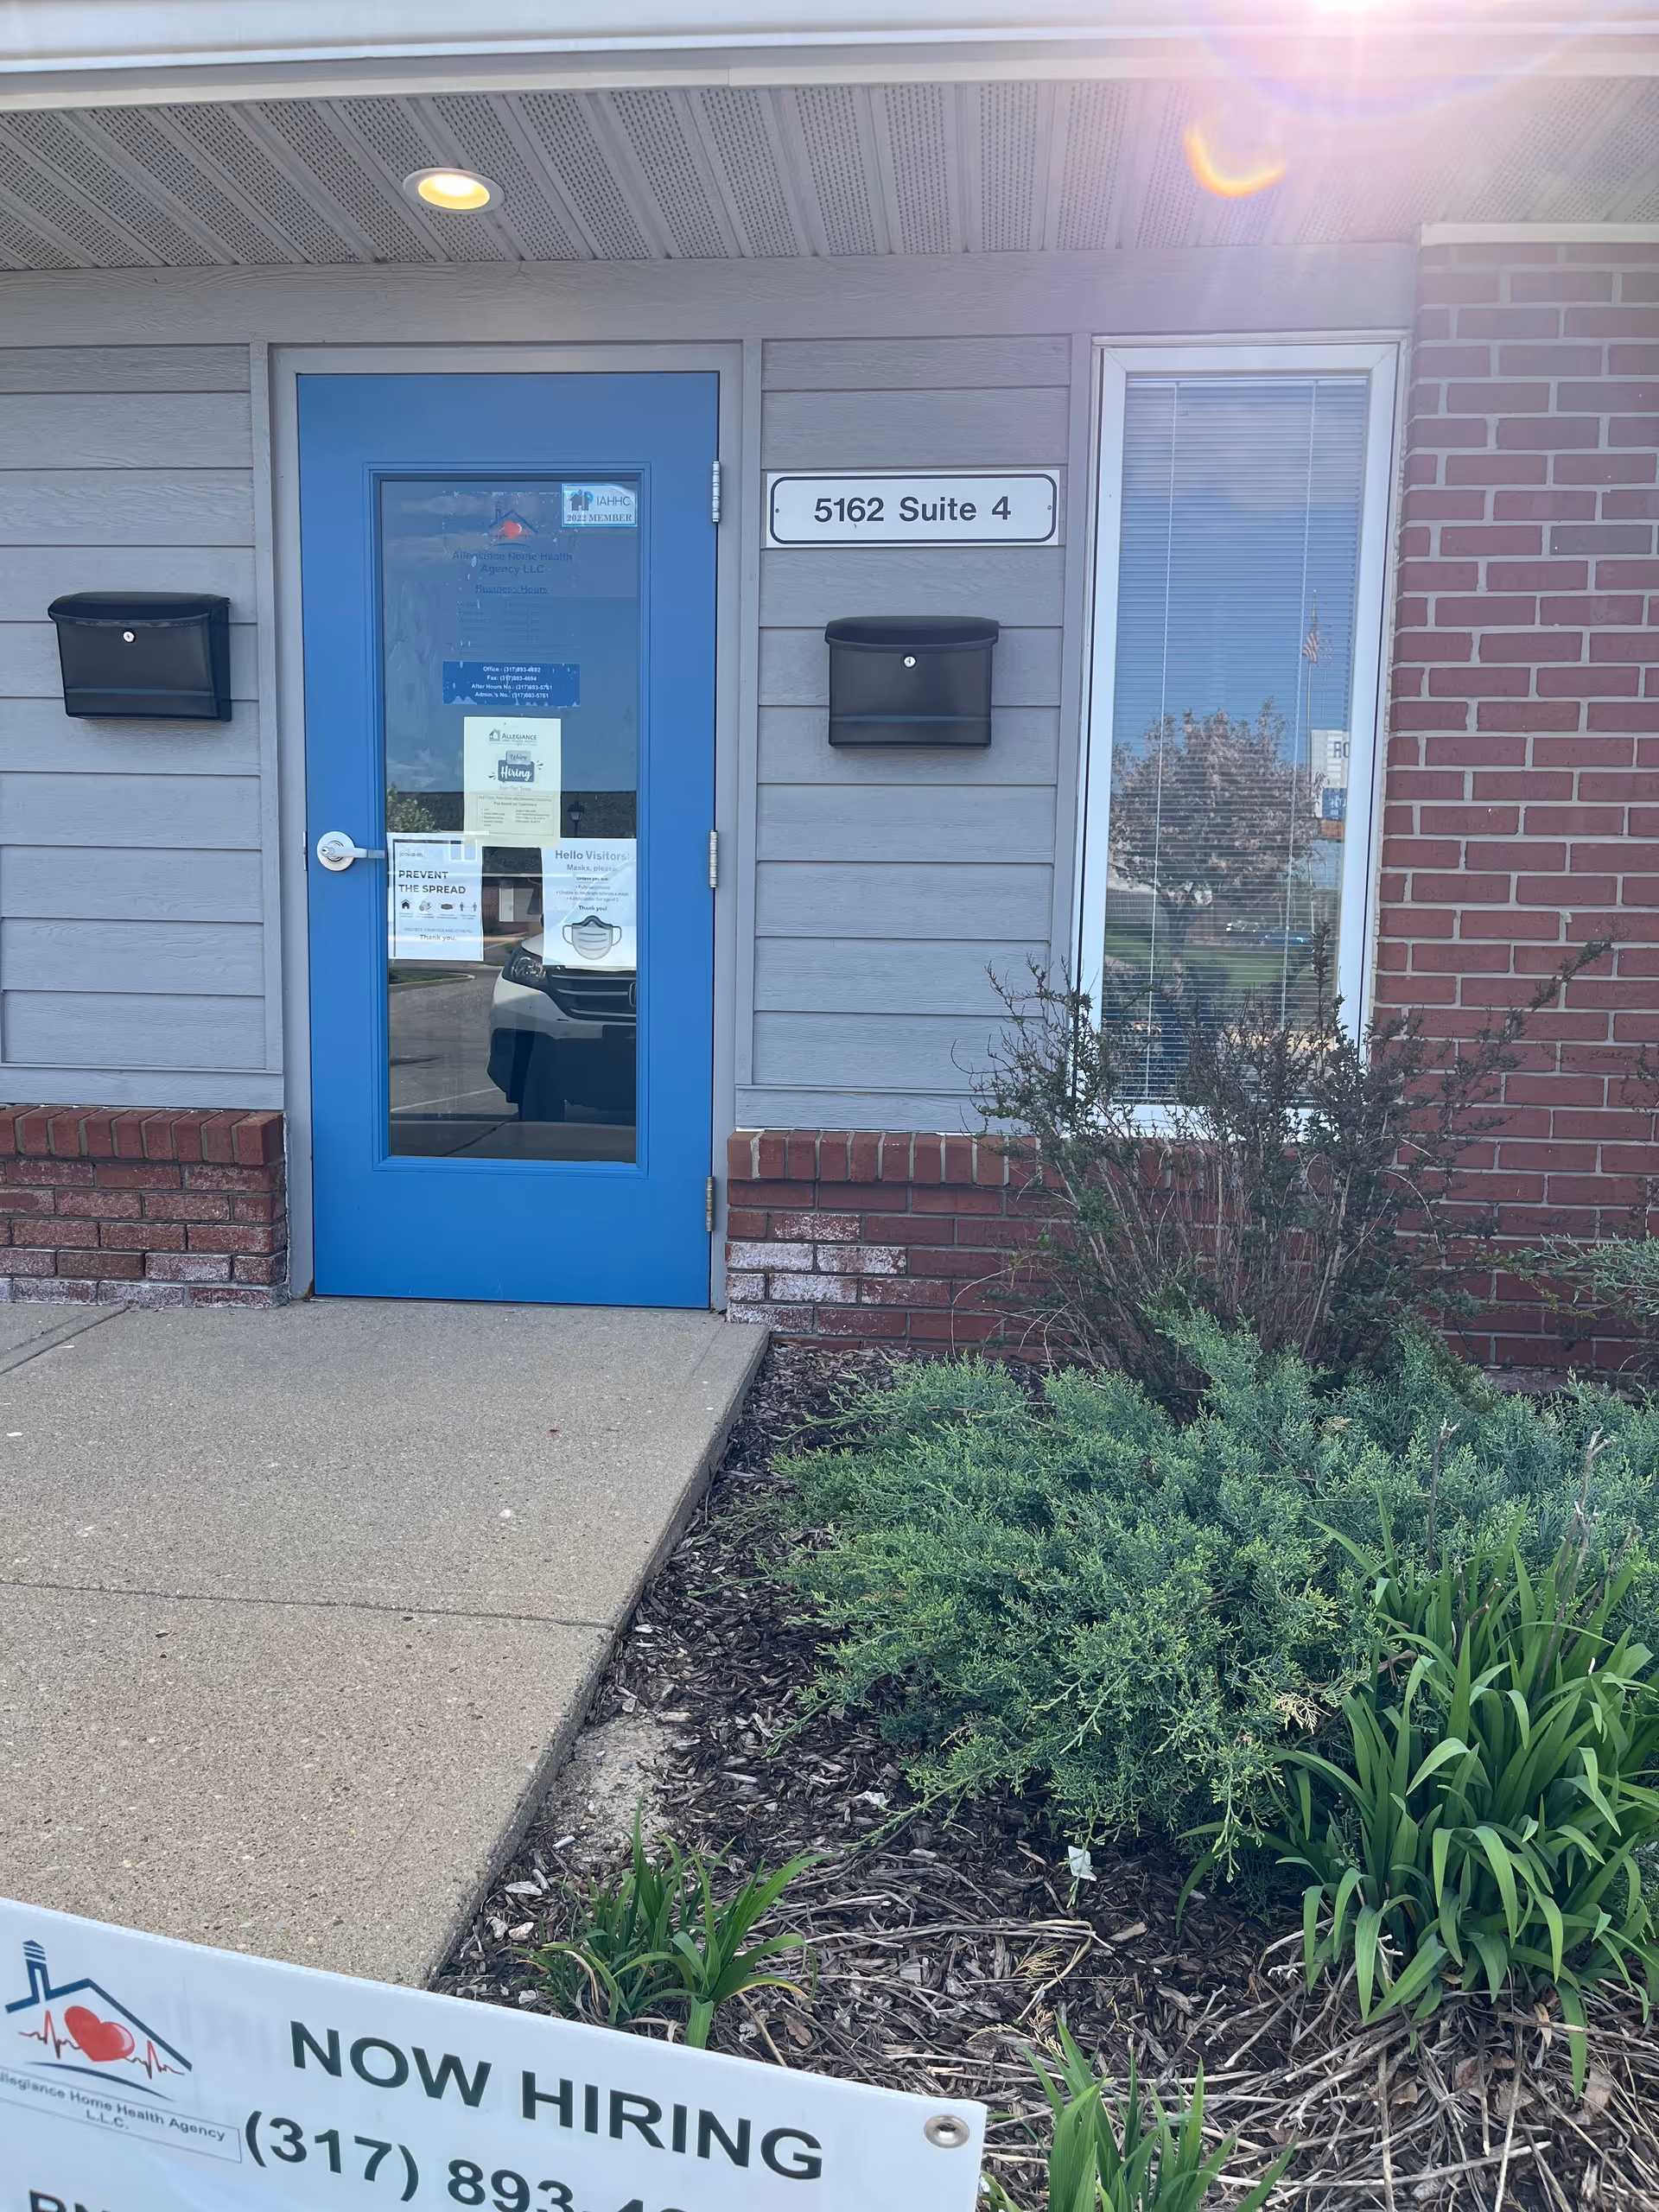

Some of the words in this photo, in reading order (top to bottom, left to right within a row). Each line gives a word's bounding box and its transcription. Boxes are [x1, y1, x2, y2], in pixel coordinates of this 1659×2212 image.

[596, 496, 631, 506] IAHHC
[814, 498, 885, 523] 5162
[899, 496, 976, 522] Suite
[991, 496, 1011, 520] 4
[541, 552, 573, 561] Health
[480, 564, 519, 575] Agency
[524, 565, 544, 574] LLC
[476, 584, 518, 594] Business
[521, 586, 548, 594] Hours
[500, 766, 532, 782] Hiring
[555, 849, 583, 860] Hello
[398, 870, 448, 879] PREVENT
[398, 884, 419, 893] THE
[422, 885, 466, 893] SPREAD
[289, 2020, 493, 2108] NOW
[520, 2070, 823, 2181] HIRING
[70, 2089, 113, 2112] Home
[117, 2102, 165, 2126] Health
[168, 2117, 226, 2142] Agency
[245, 2110, 420, 2202] (317)
